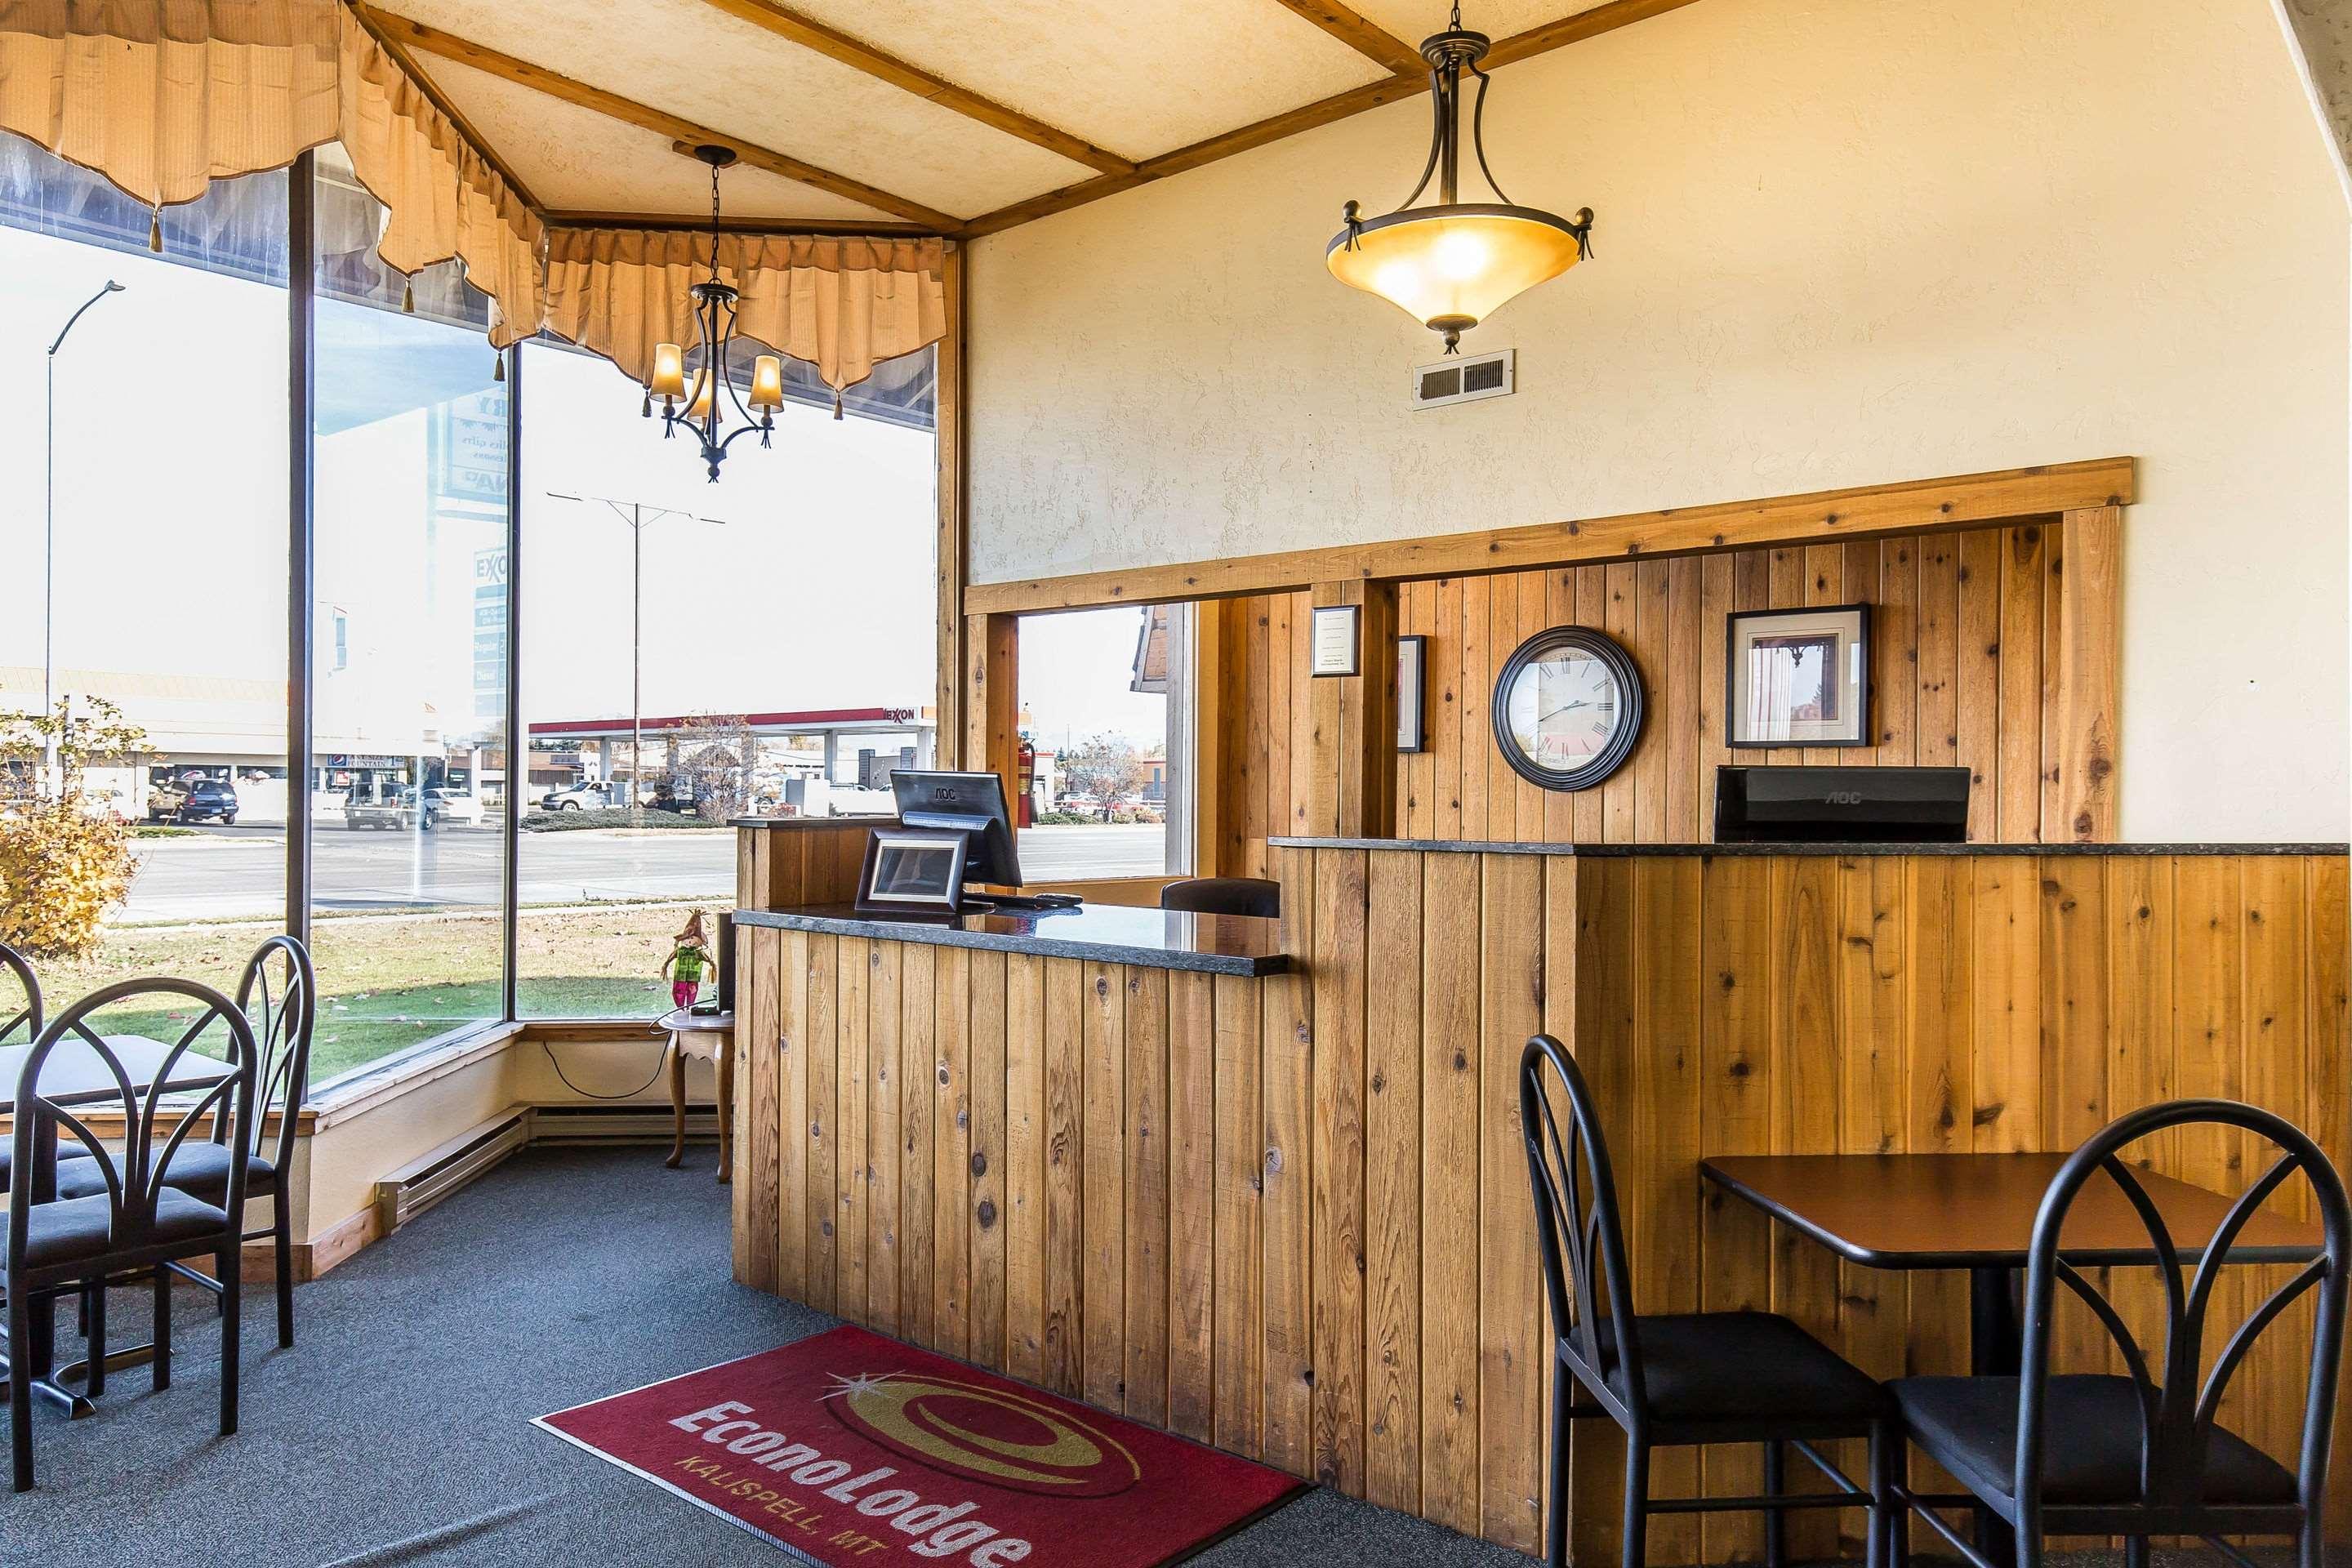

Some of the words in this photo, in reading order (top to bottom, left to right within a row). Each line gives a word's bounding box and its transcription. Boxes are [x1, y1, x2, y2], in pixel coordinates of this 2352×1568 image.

[886, 708, 915, 724] EXXON
[935, 787, 956, 801] AOC
[1825, 791, 1863, 804] AOC
[667, 1400, 1032, 1568] EconoLodge
[828, 1528, 890, 1556] MT
